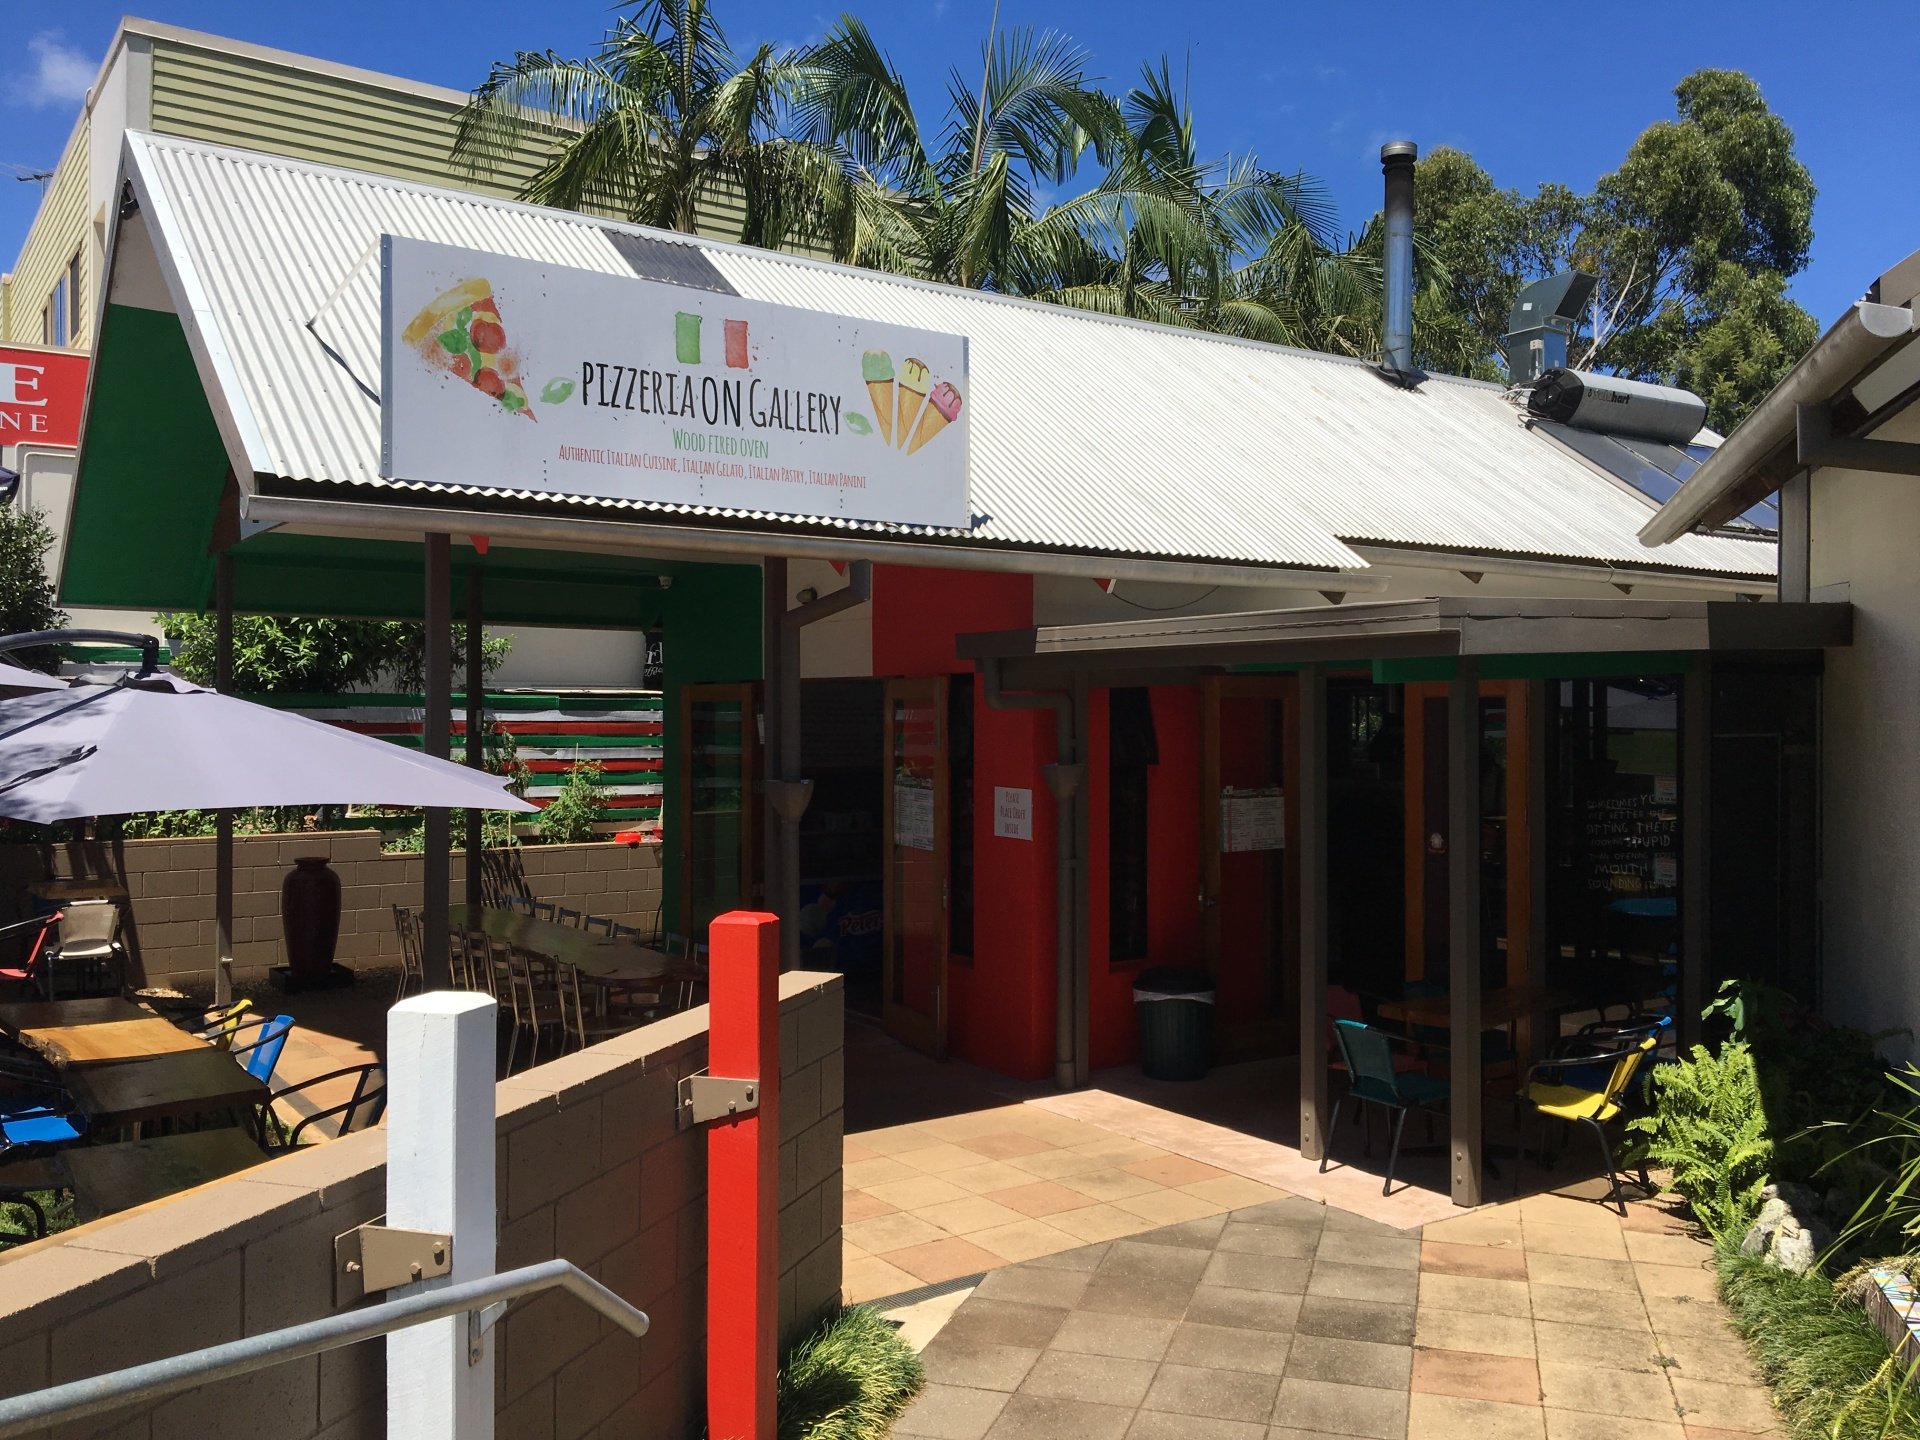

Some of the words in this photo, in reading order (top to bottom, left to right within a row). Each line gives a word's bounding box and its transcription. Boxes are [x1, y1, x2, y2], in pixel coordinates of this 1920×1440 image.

[582, 361, 696, 419] PIZZERIA
[701, 376, 741, 428] ON
[749, 378, 841, 435] GALLERY
[672, 428, 706, 453] WOOD
[708, 434, 738, 456] FIRED
[740, 437, 769, 459] OVEN
[558, 444, 605, 465] AUTHENTIC
[606, 449, 642, 468] ITALIAN
[643, 453, 681, 473] CUISINE,
[683, 457, 715, 476] ITALIAN
[716, 460, 747, 480] GELATO,
[748, 463, 780, 482] ITALIAN
[781, 467, 808, 485] PASTRY,
[808, 469, 839, 487] ITALIAN
[839, 472, 867, 489] PANINI
[1586, 820, 1629, 836] SITTING
[1636, 821, 1678, 835] THERE
[1594, 863, 1649, 877] MOUTH
[837, 909, 882, 936] Peter
